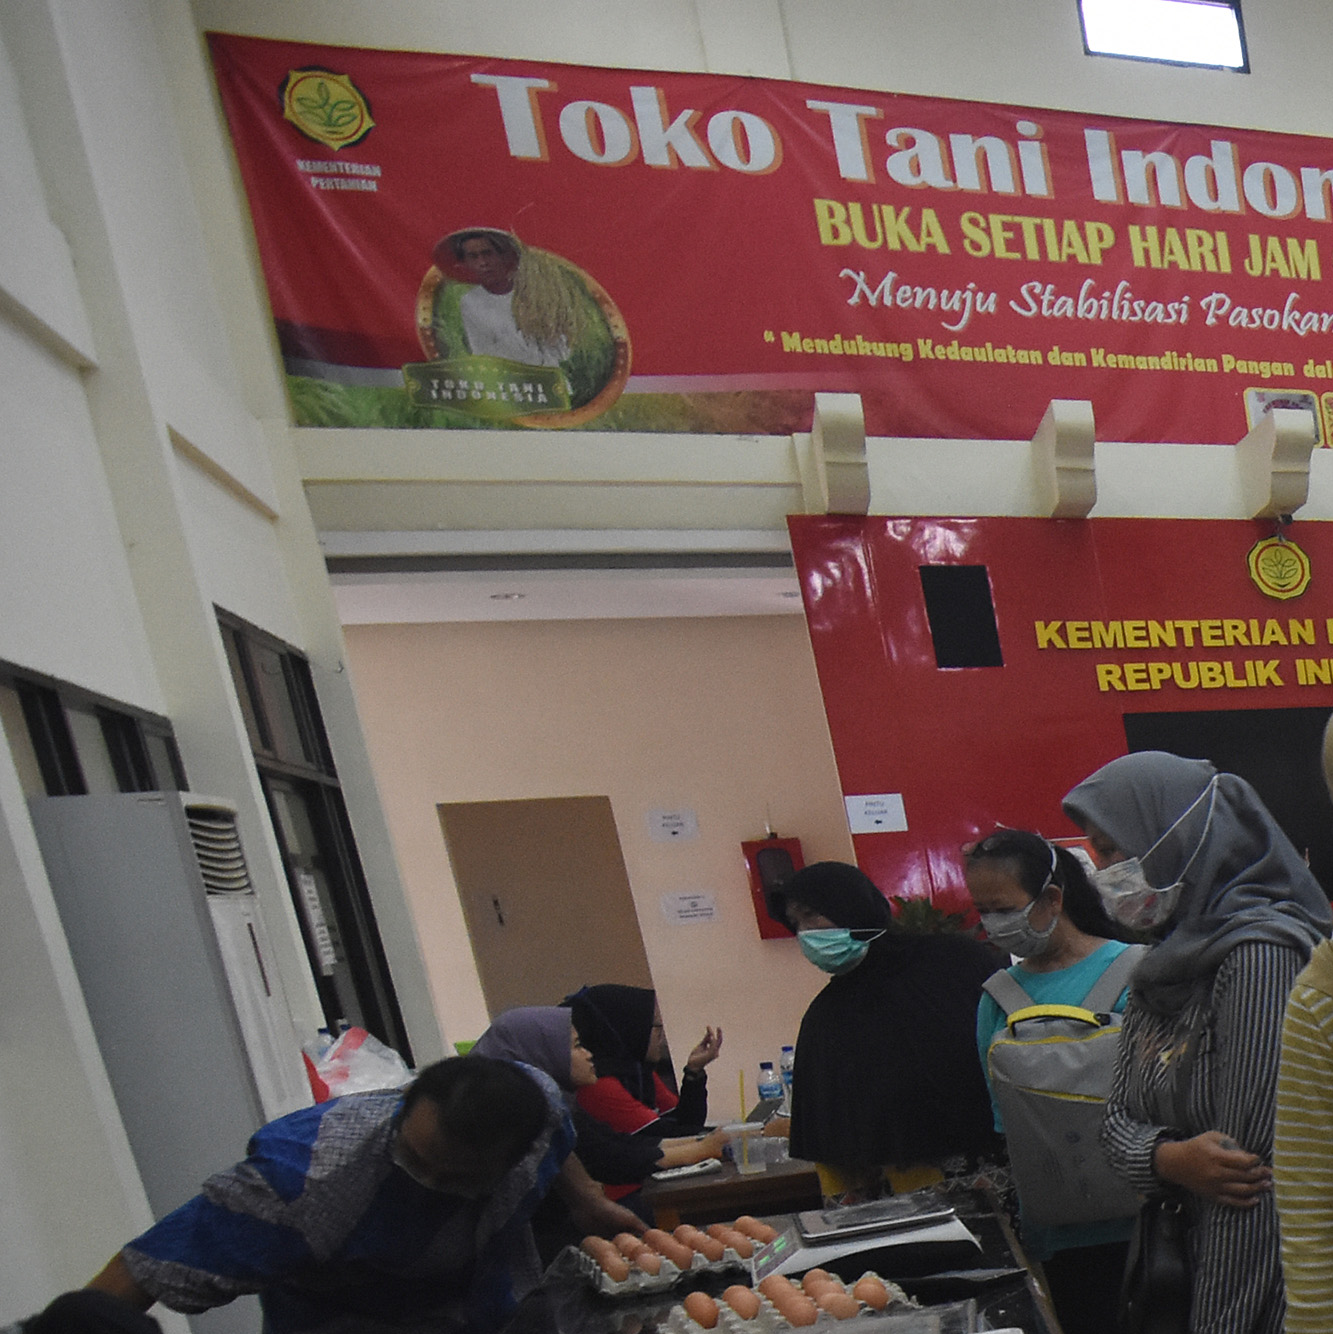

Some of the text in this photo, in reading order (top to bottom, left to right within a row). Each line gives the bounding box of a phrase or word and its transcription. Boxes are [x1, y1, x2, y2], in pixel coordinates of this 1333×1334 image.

[470, 73, 780, 174] Toko
[806, 99, 1051, 199] Tani
[813, 198, 951, 255] BUKA
[960, 211, 1116, 265] SETIAP
[1128, 224, 1232, 274] HARI
[1243, 233, 1322, 282] JAM
[838, 267, 999, 331] Menuju
[1008, 277, 1191, 325] Stabilisasi
[781, 331, 914, 362] Mendukung
[917, 337, 1043, 366] Kedaulatan
[1047, 345, 1088, 368] dan
[1092, 348, 1219, 374] Kemandirian
[1223, 353, 1296, 379] Pangan
[1034, 618, 1316, 650] KEMENTERIAN
[1095, 659, 1285, 693] REPUBLIK
